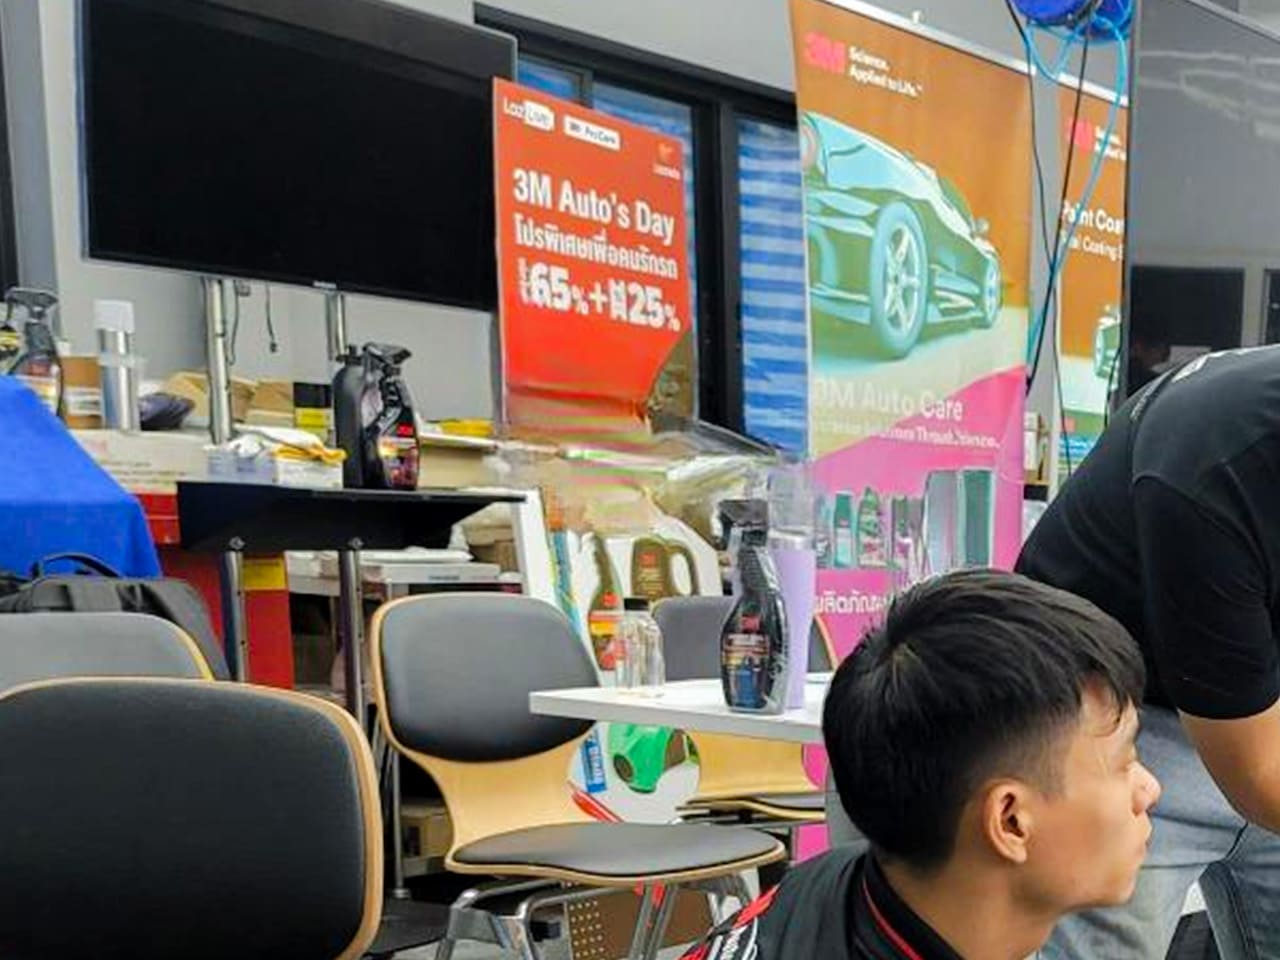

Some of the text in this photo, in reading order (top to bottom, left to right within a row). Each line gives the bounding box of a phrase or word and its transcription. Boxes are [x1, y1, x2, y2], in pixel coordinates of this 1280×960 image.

[513, 167, 675, 246] 3M Auto's Day
[530, 262, 589, 315] 65%
[860, 381, 915, 417] Auto
[920, 391, 964, 421] Care
